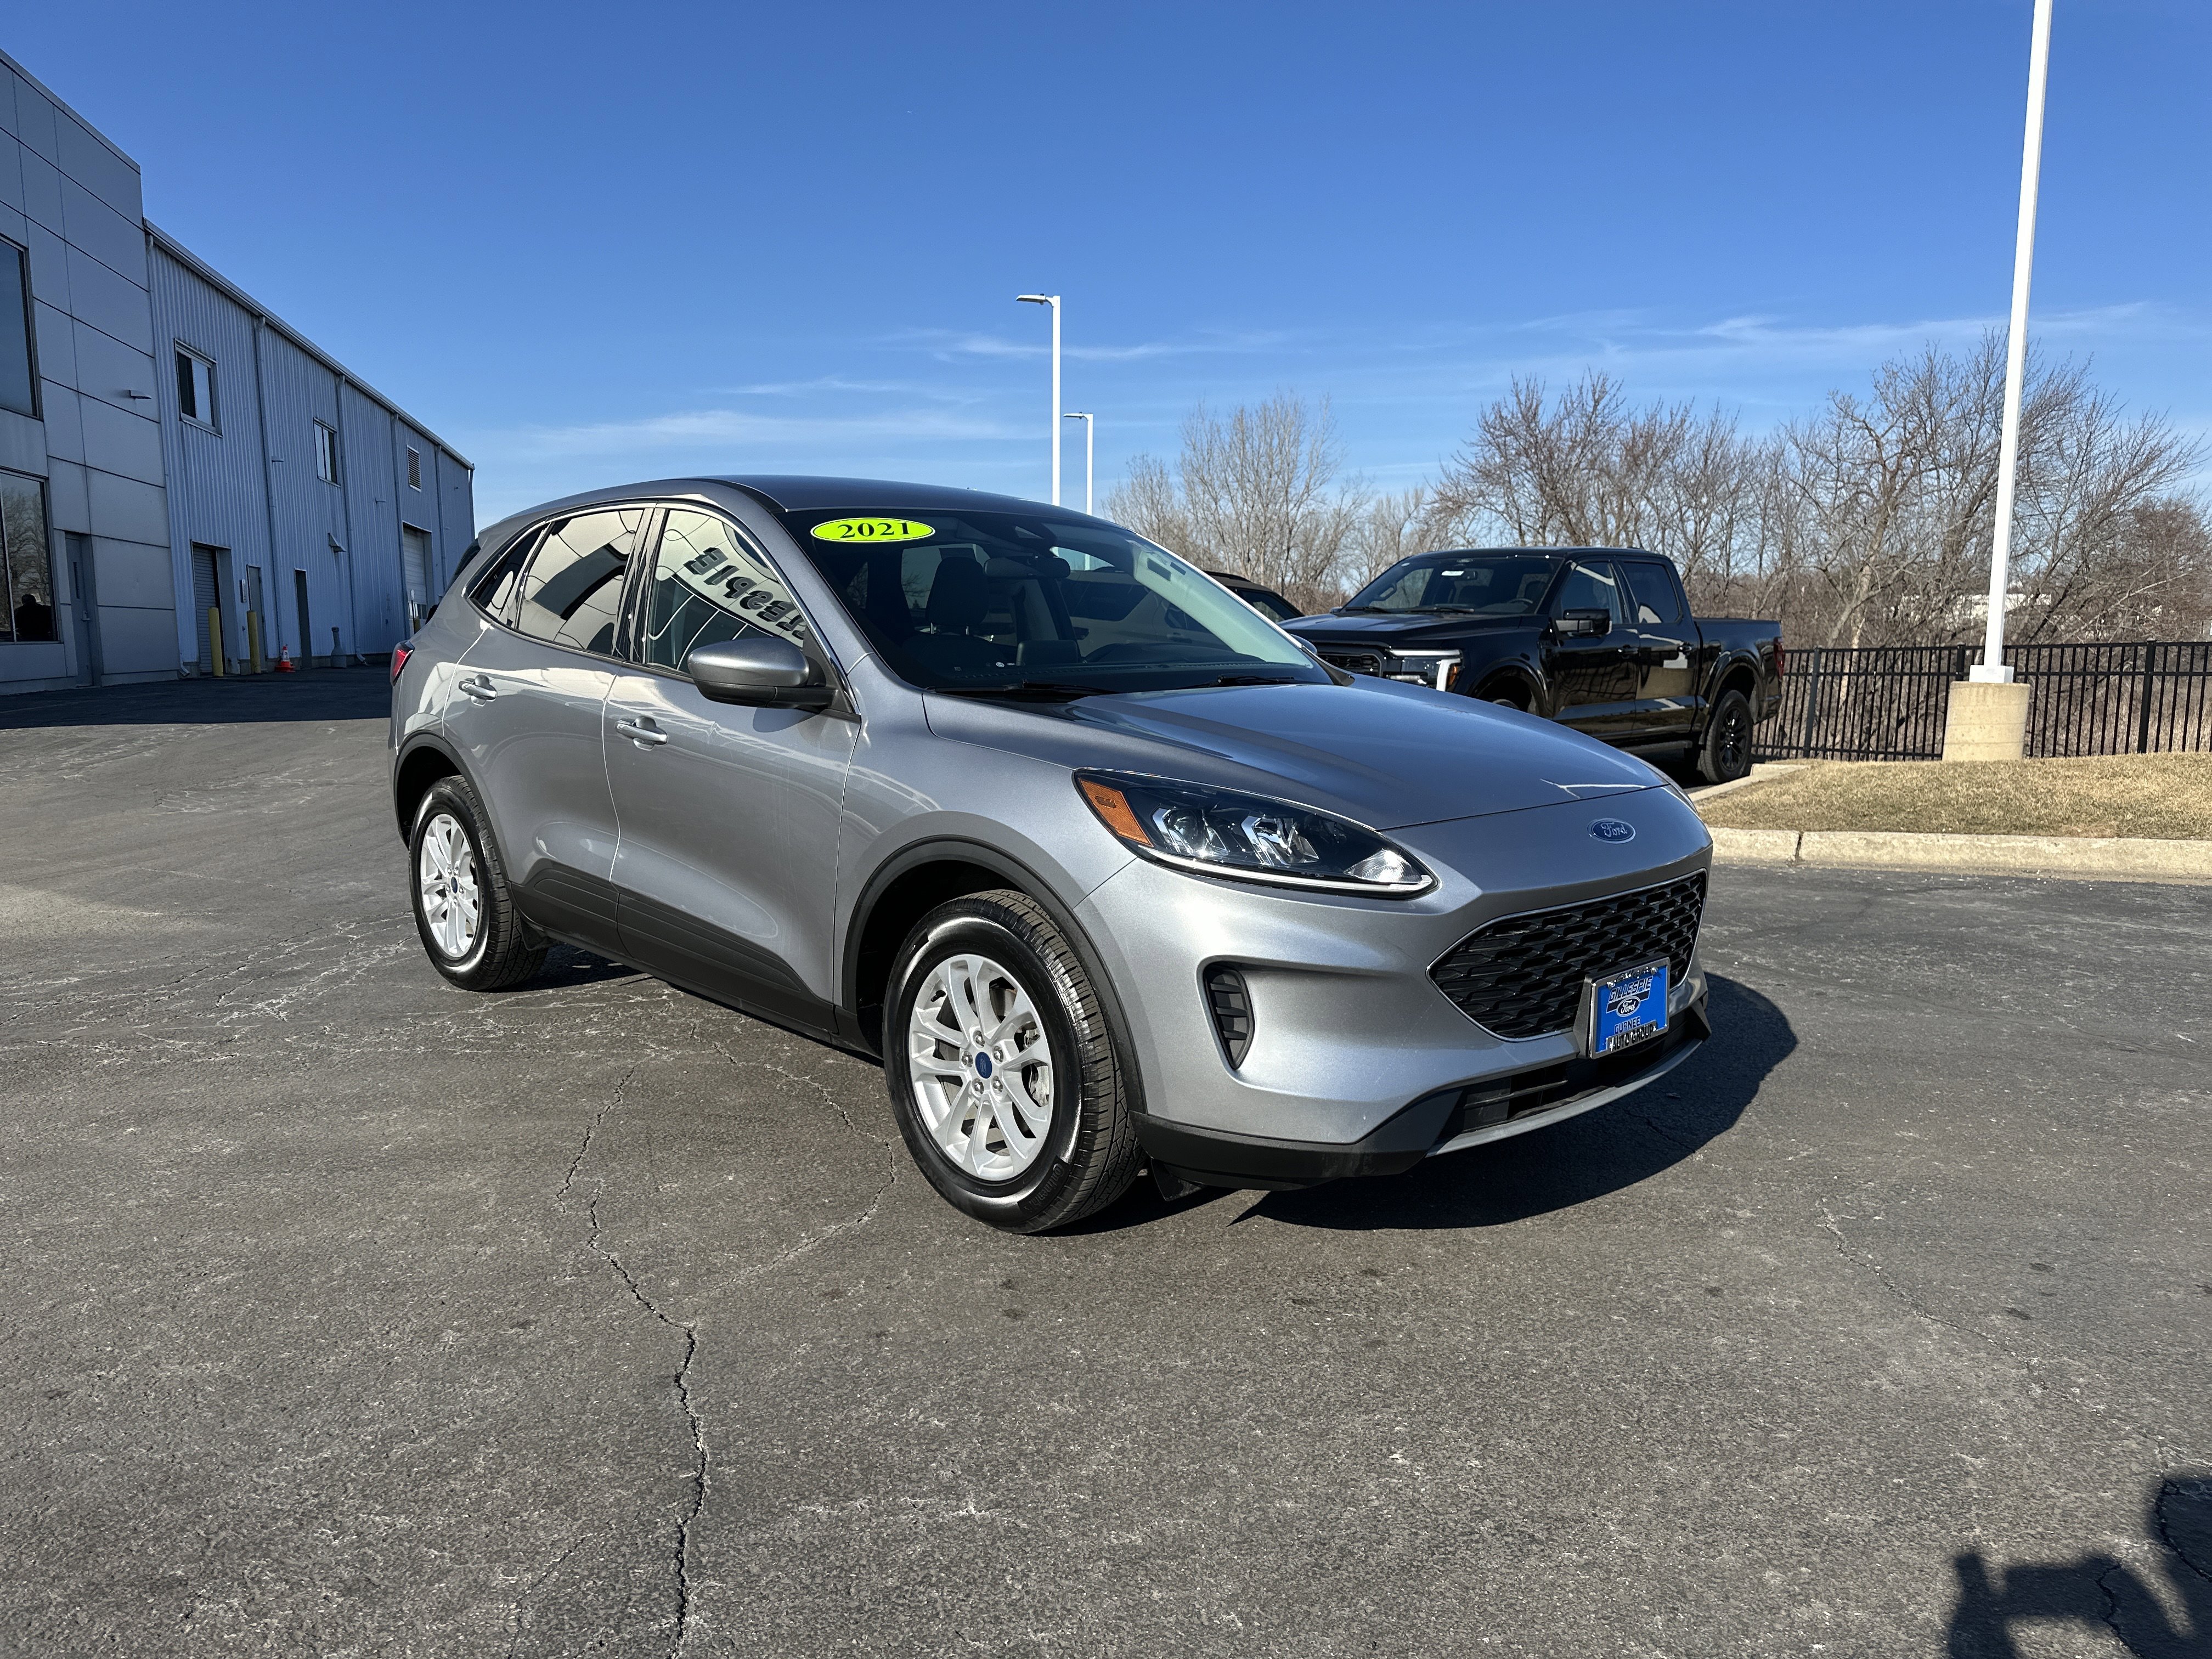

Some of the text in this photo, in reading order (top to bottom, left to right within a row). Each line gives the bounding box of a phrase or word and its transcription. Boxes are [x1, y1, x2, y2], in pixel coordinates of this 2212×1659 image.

[837, 522, 913, 539] 2021
[1600, 822, 1628, 838] Ford
[1609, 975, 1654, 1002] GILLESPIE
[1621, 1000, 1635, 1014] Ford
[1614, 1016, 1641, 1034] GURNEE
[1610, 1023, 1656, 1052] AUTO GROUP
